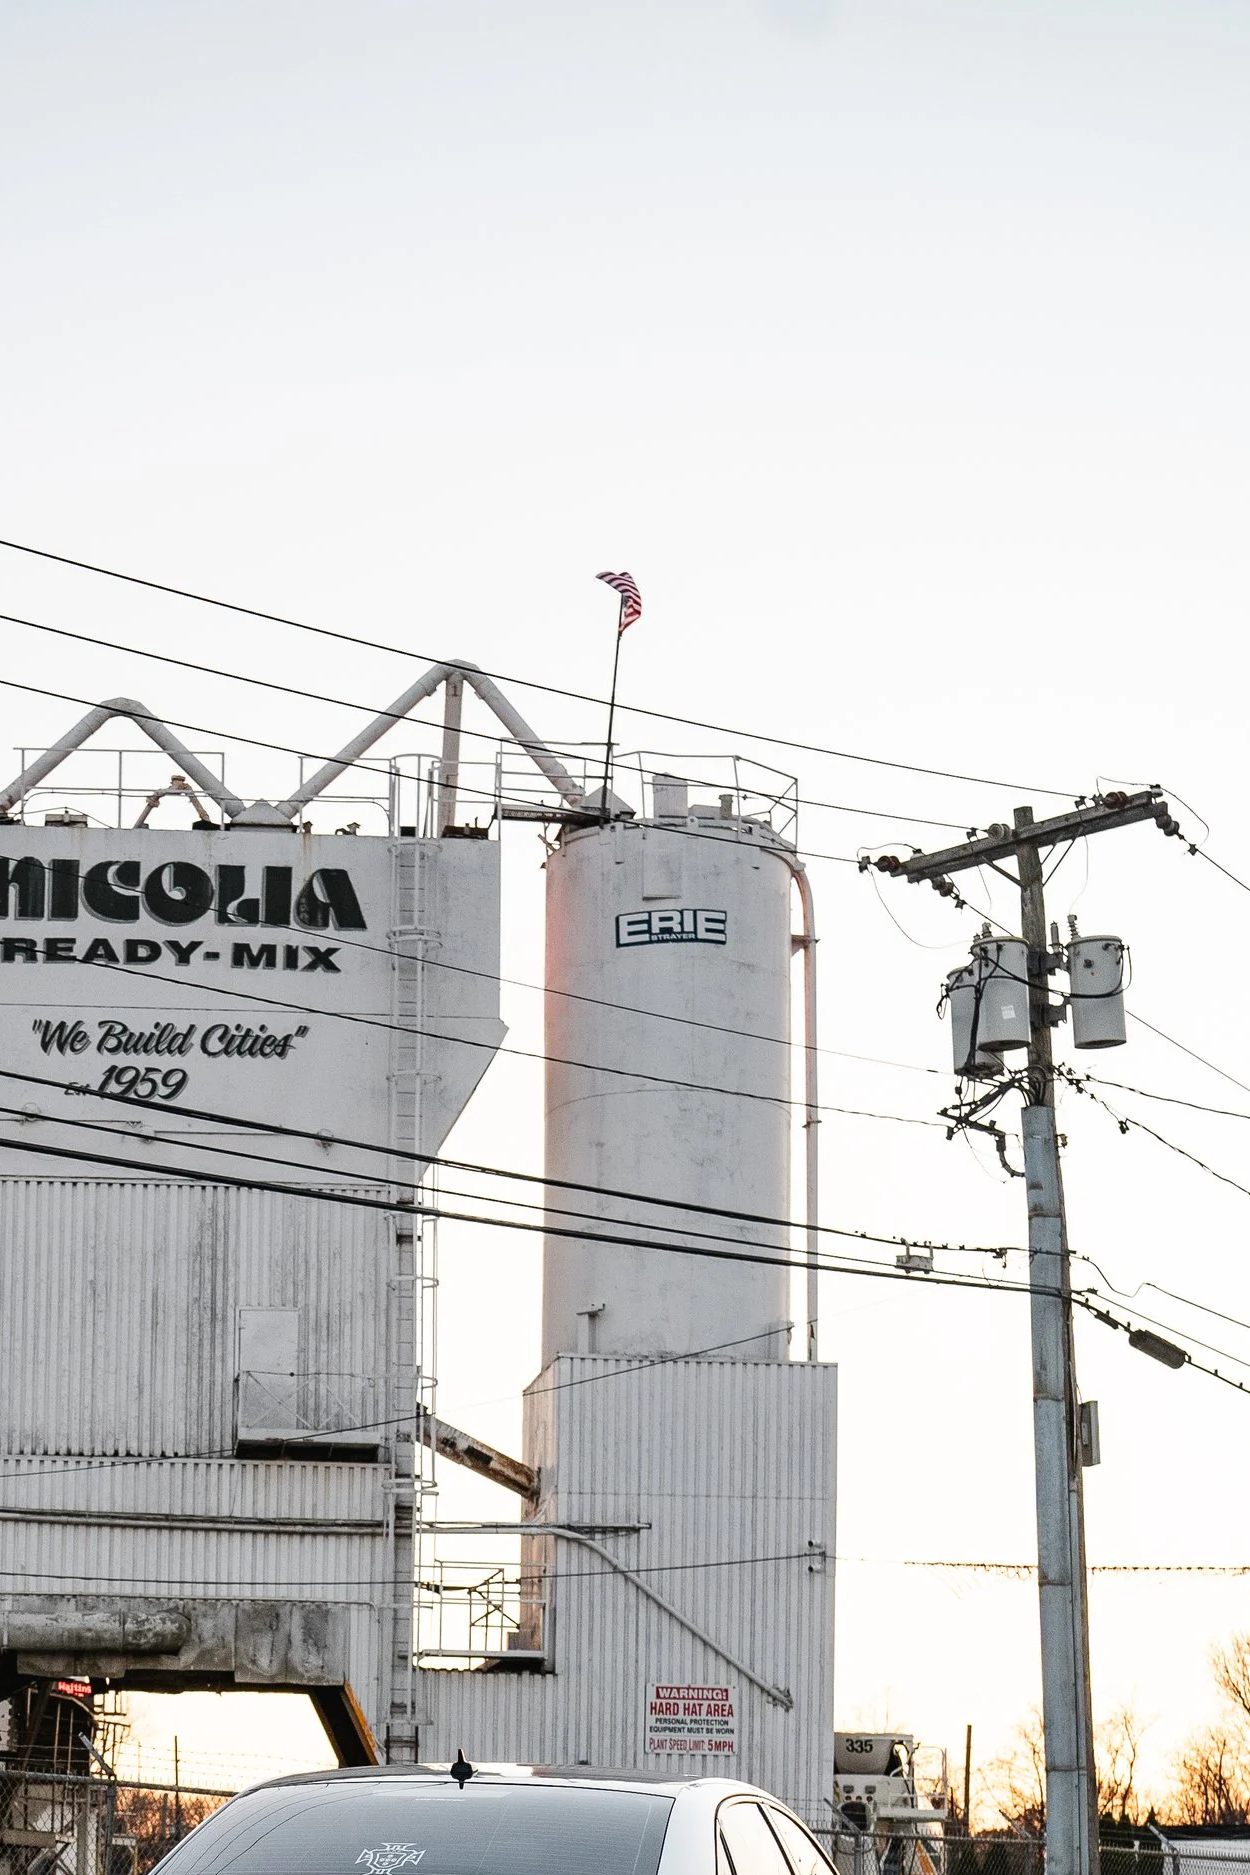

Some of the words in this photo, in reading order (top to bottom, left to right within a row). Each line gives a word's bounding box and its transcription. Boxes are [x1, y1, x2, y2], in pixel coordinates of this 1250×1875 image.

[616, 909, 727, 947] ERIE
[651, 932, 697, 941] STRAYER
[0, 937, 342, 973] READY-MIX
[97, 1020, 197, 1057] Build
[98, 1064, 189, 1101] 1959
[658, 1687, 726, 1700] WARNING:
[650, 1702, 680, 1716] HARD
[683, 1702, 703, 1717] HAT
[706, 1703, 734, 1718] AREA
[655, 1718, 688, 1726] PERSONAL
[690, 1719, 729, 1727] PROTECTION
[649, 1726, 686, 1734] EQUIPMENT
[687, 1727, 704, 1735] MUST
[715, 1728, 734, 1736] WORN
[845, 1738, 873, 1754] 335
